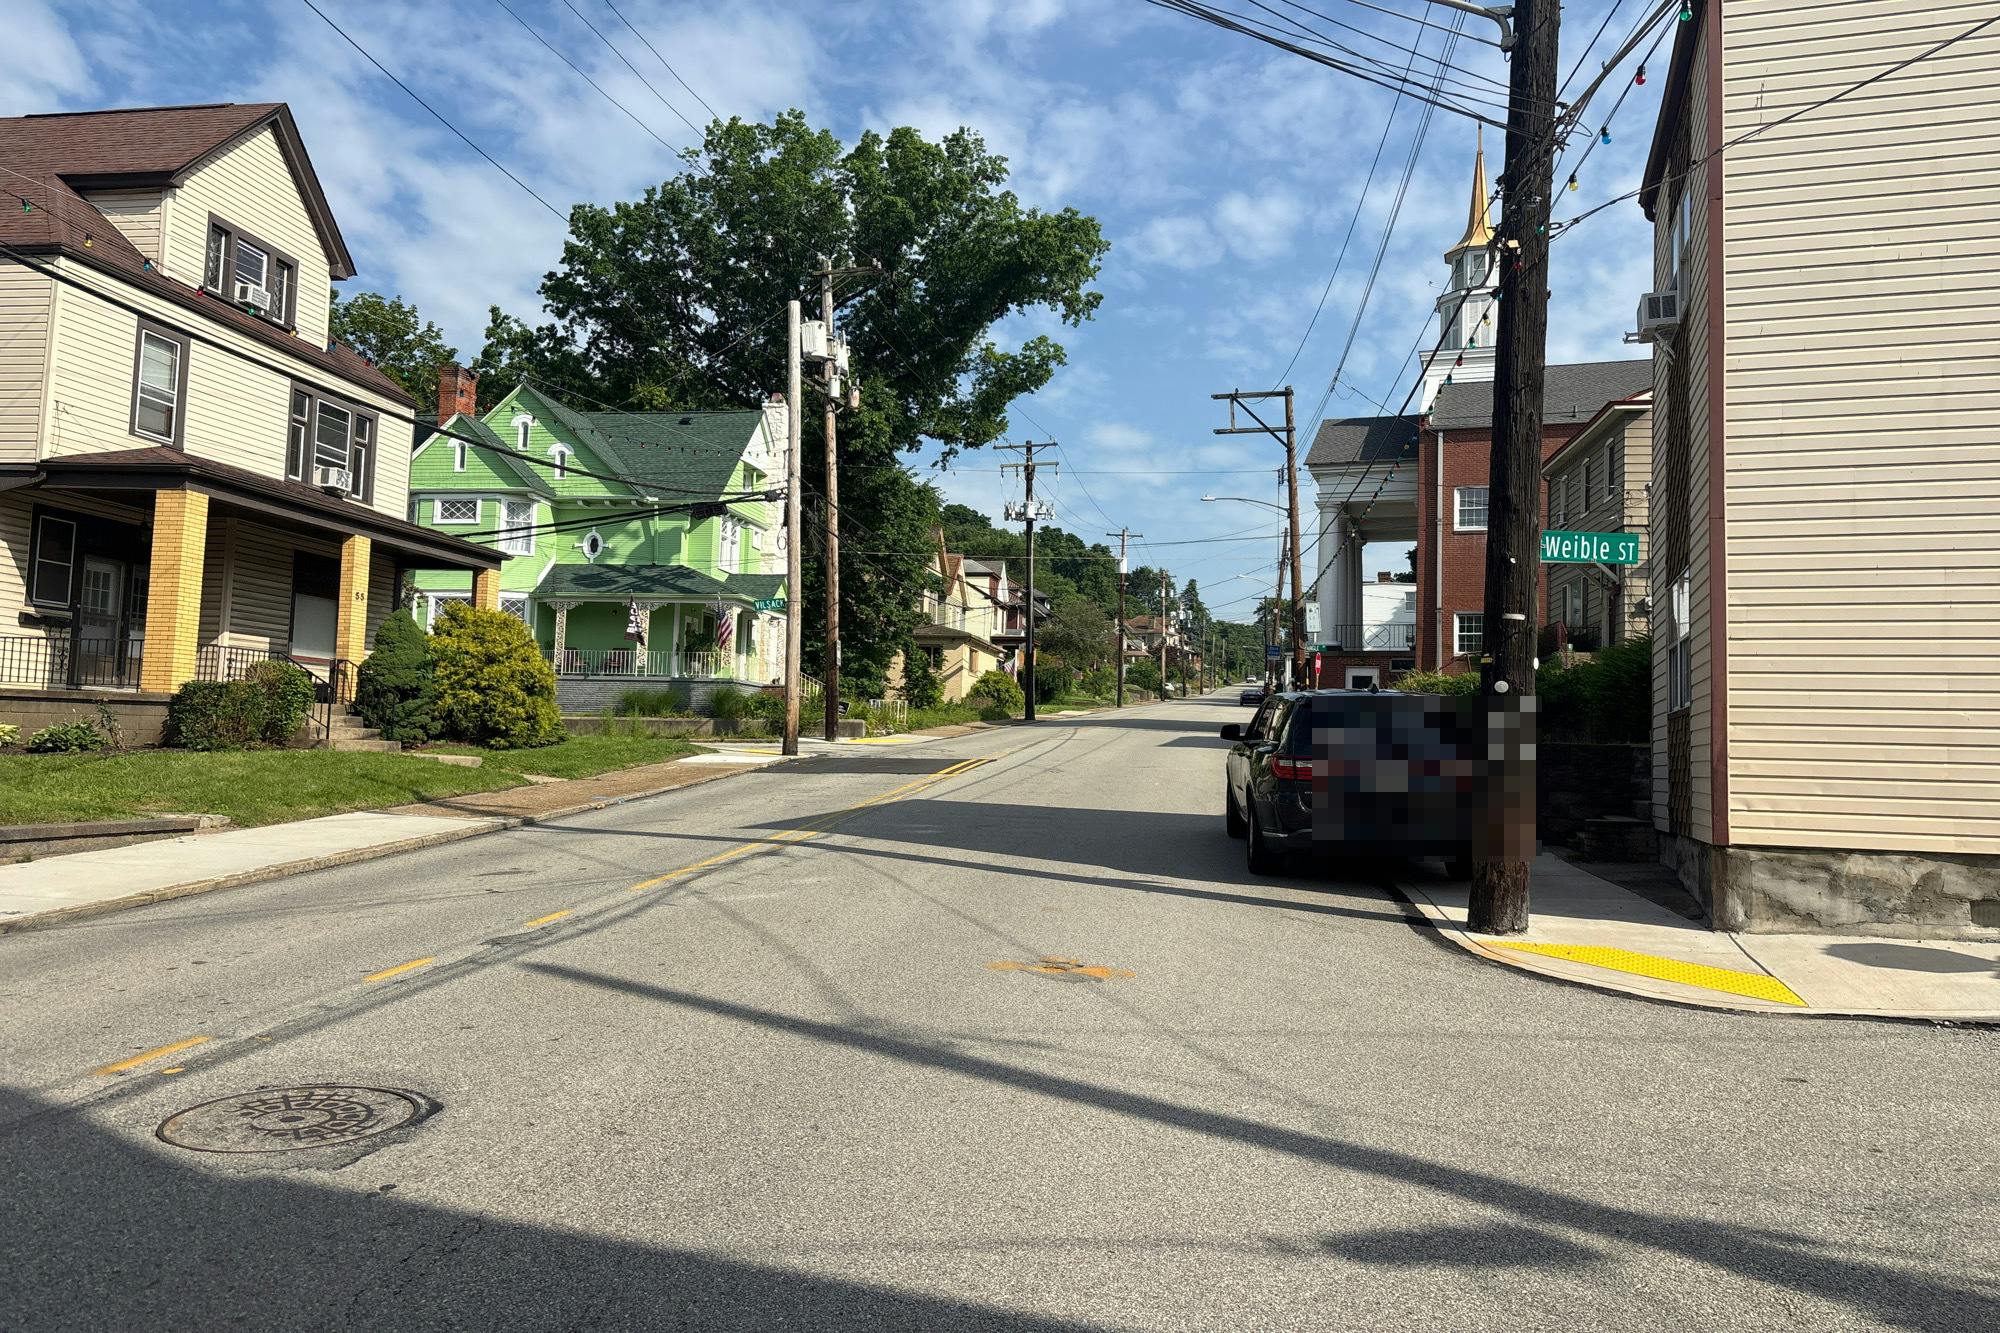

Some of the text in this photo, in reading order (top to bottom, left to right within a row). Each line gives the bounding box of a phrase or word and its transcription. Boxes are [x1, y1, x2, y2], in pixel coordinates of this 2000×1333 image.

[1545, 535, 1636, 561] Weible ST
[355, 592, 365, 601] 55
[755, 600, 785, 610] VILSACK
